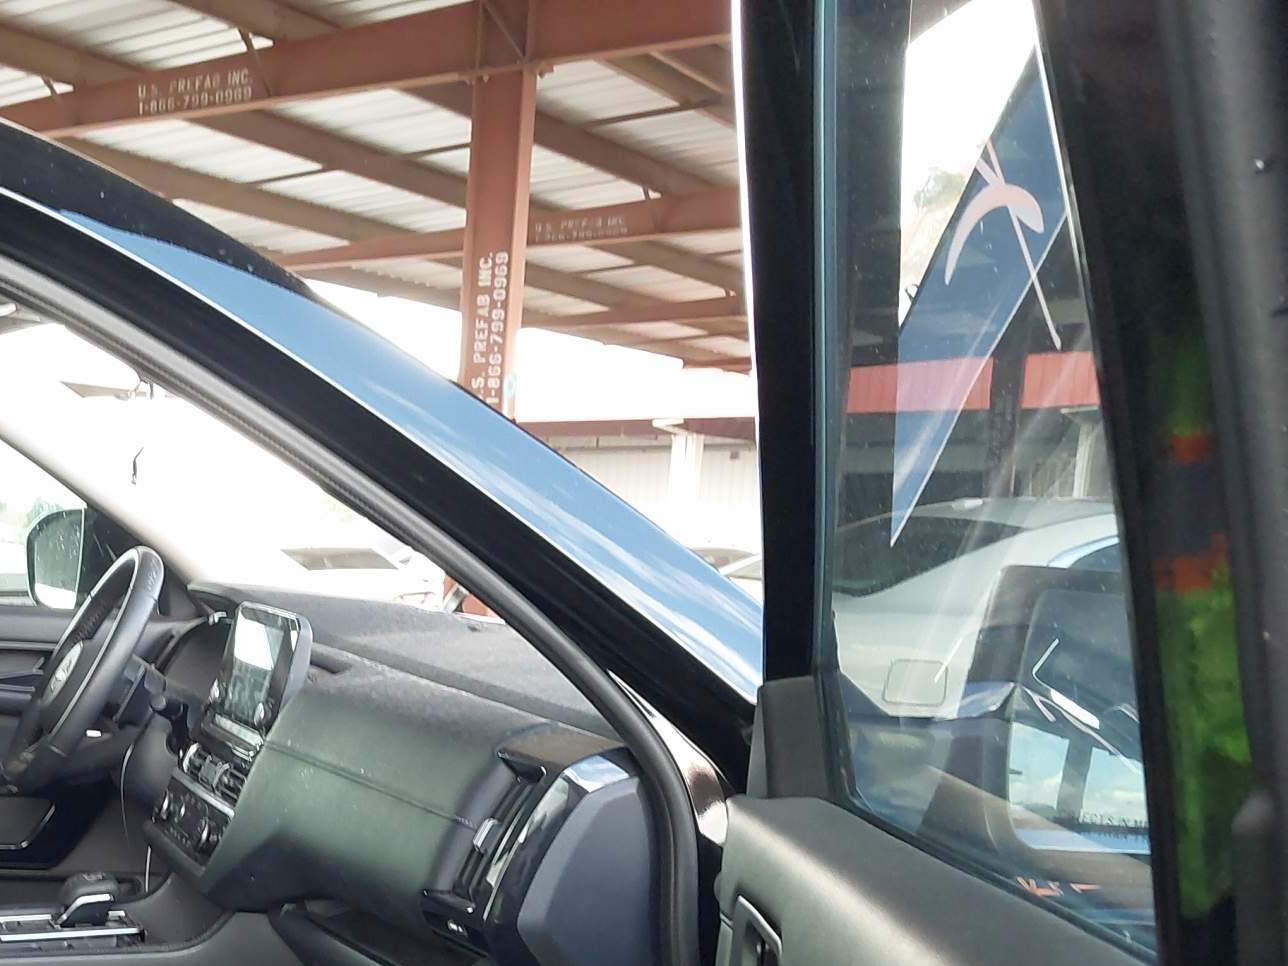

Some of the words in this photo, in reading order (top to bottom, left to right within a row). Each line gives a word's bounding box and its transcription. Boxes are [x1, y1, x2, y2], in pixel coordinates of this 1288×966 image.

[478, 252, 493, 287] INC.
[473, 294, 490, 364] PREFAB
[486, 251, 509, 404] 1-866-799-0969
[471, 371, 486, 400] .S.
